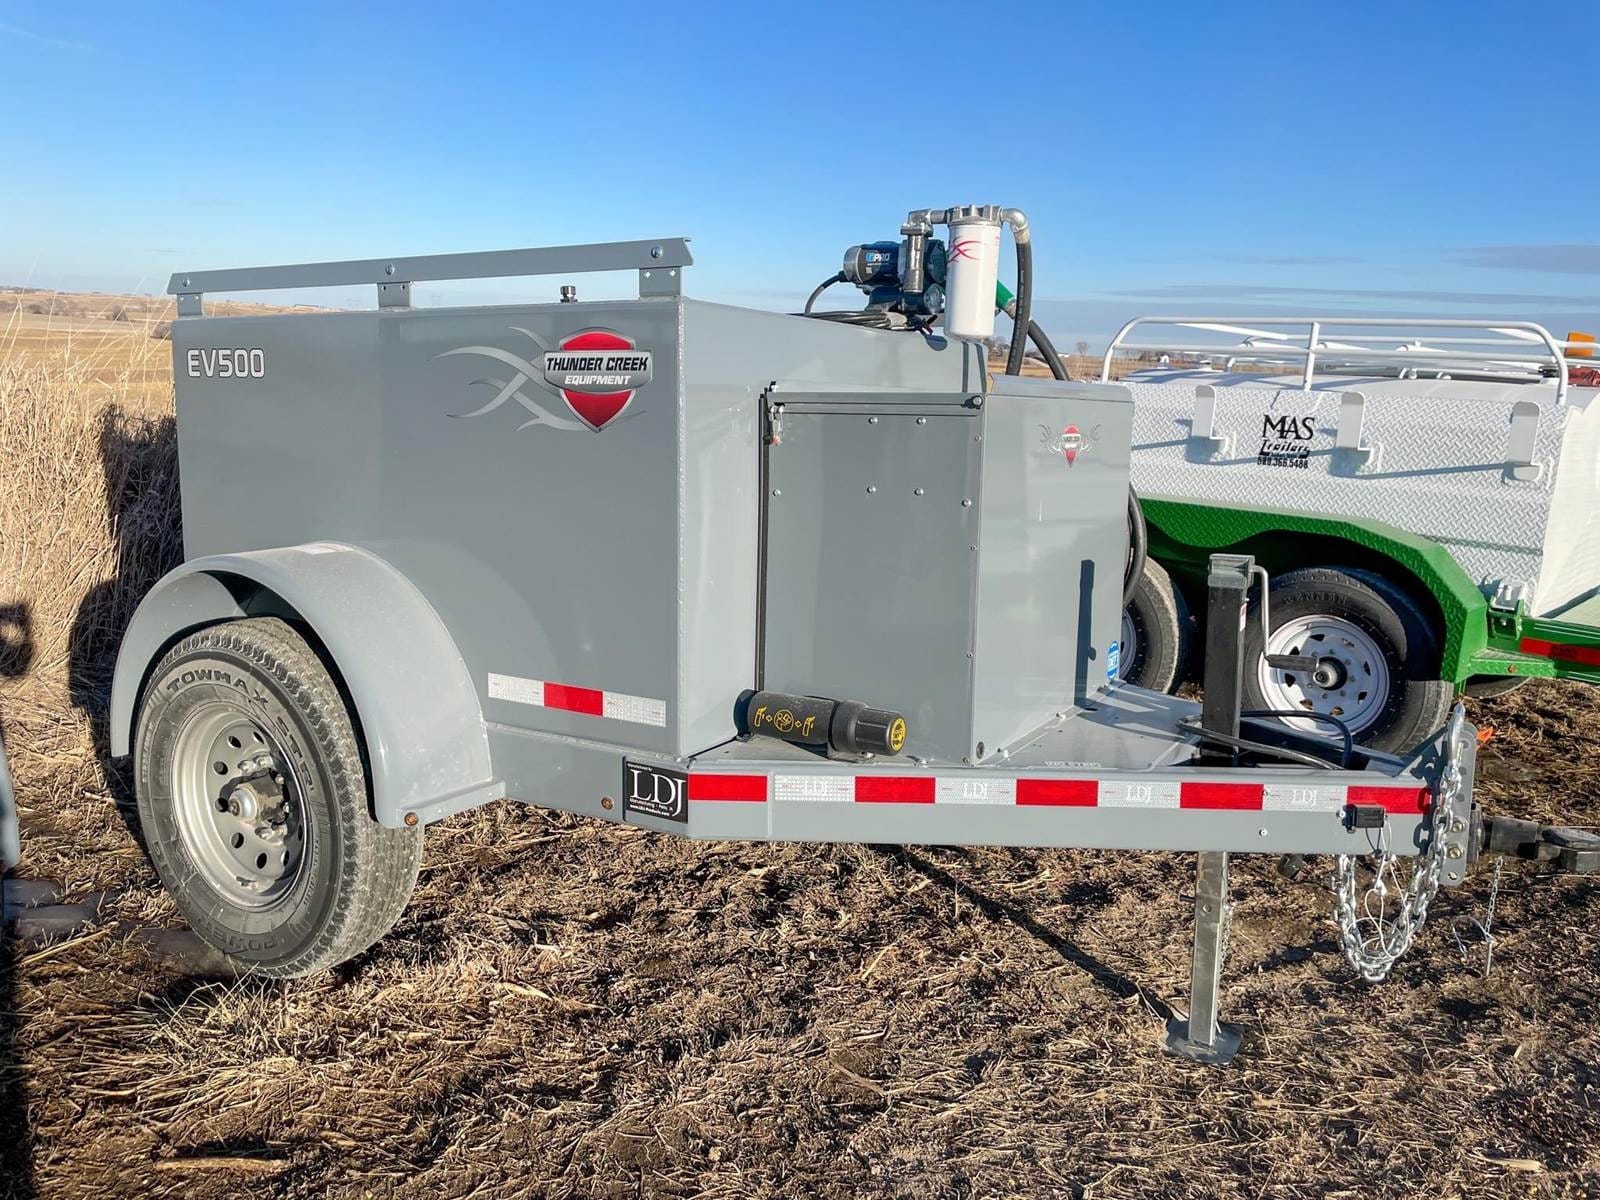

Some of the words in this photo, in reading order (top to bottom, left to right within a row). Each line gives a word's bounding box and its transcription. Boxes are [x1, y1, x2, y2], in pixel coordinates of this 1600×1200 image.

[187, 348, 265, 378] EV500
[546, 356, 602, 372] THUNDER
[605, 356, 649, 372] CREEK
[564, 374, 633, 386] EQUIPMENT
[1262, 414, 1315, 440] MAS
[166, 669, 268, 711] TOWMAX
[629, 768, 688, 817] LDJ
[802, 779, 830, 797] LDJ
[962, 782, 989, 800] LDJ
[1126, 786, 1152, 803] LDJ
[1290, 789, 1318, 807] LDJ
